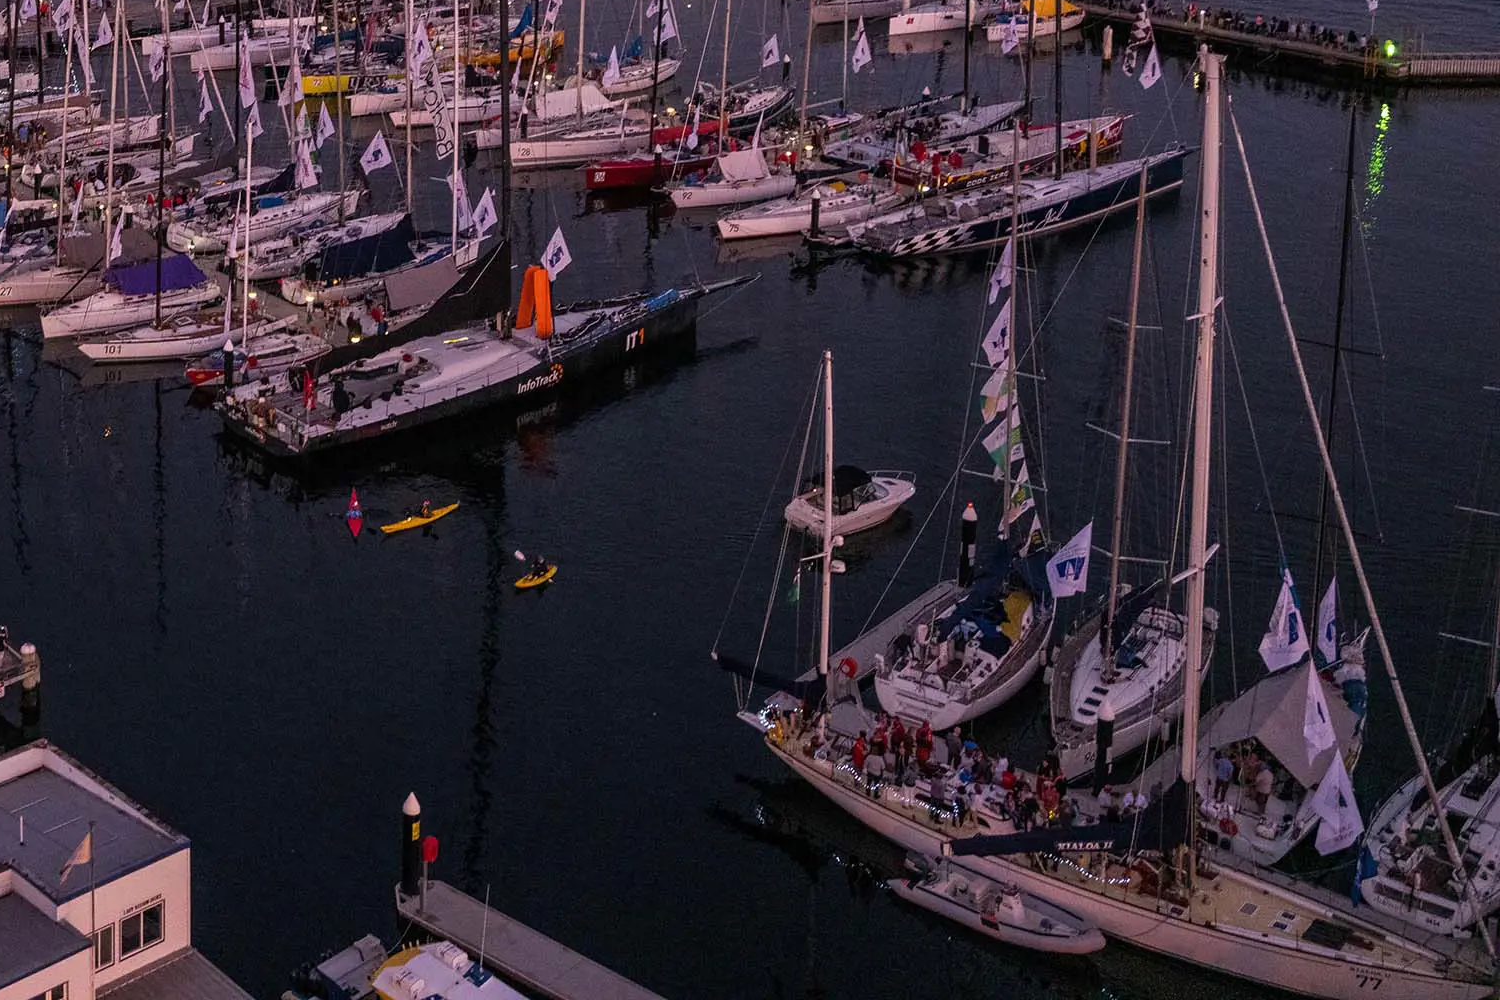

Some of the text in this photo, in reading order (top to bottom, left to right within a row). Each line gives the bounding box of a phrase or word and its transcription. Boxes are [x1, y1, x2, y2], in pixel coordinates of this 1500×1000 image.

[966, 178, 987, 188] CODE
[682, 191, 692, 200] 92
[0, 287, 12, 296] 27
[103, 345, 122, 354] 101
[517, 370, 559, 394] InfoTrack
[1356, 974, 1383, 990] 77
